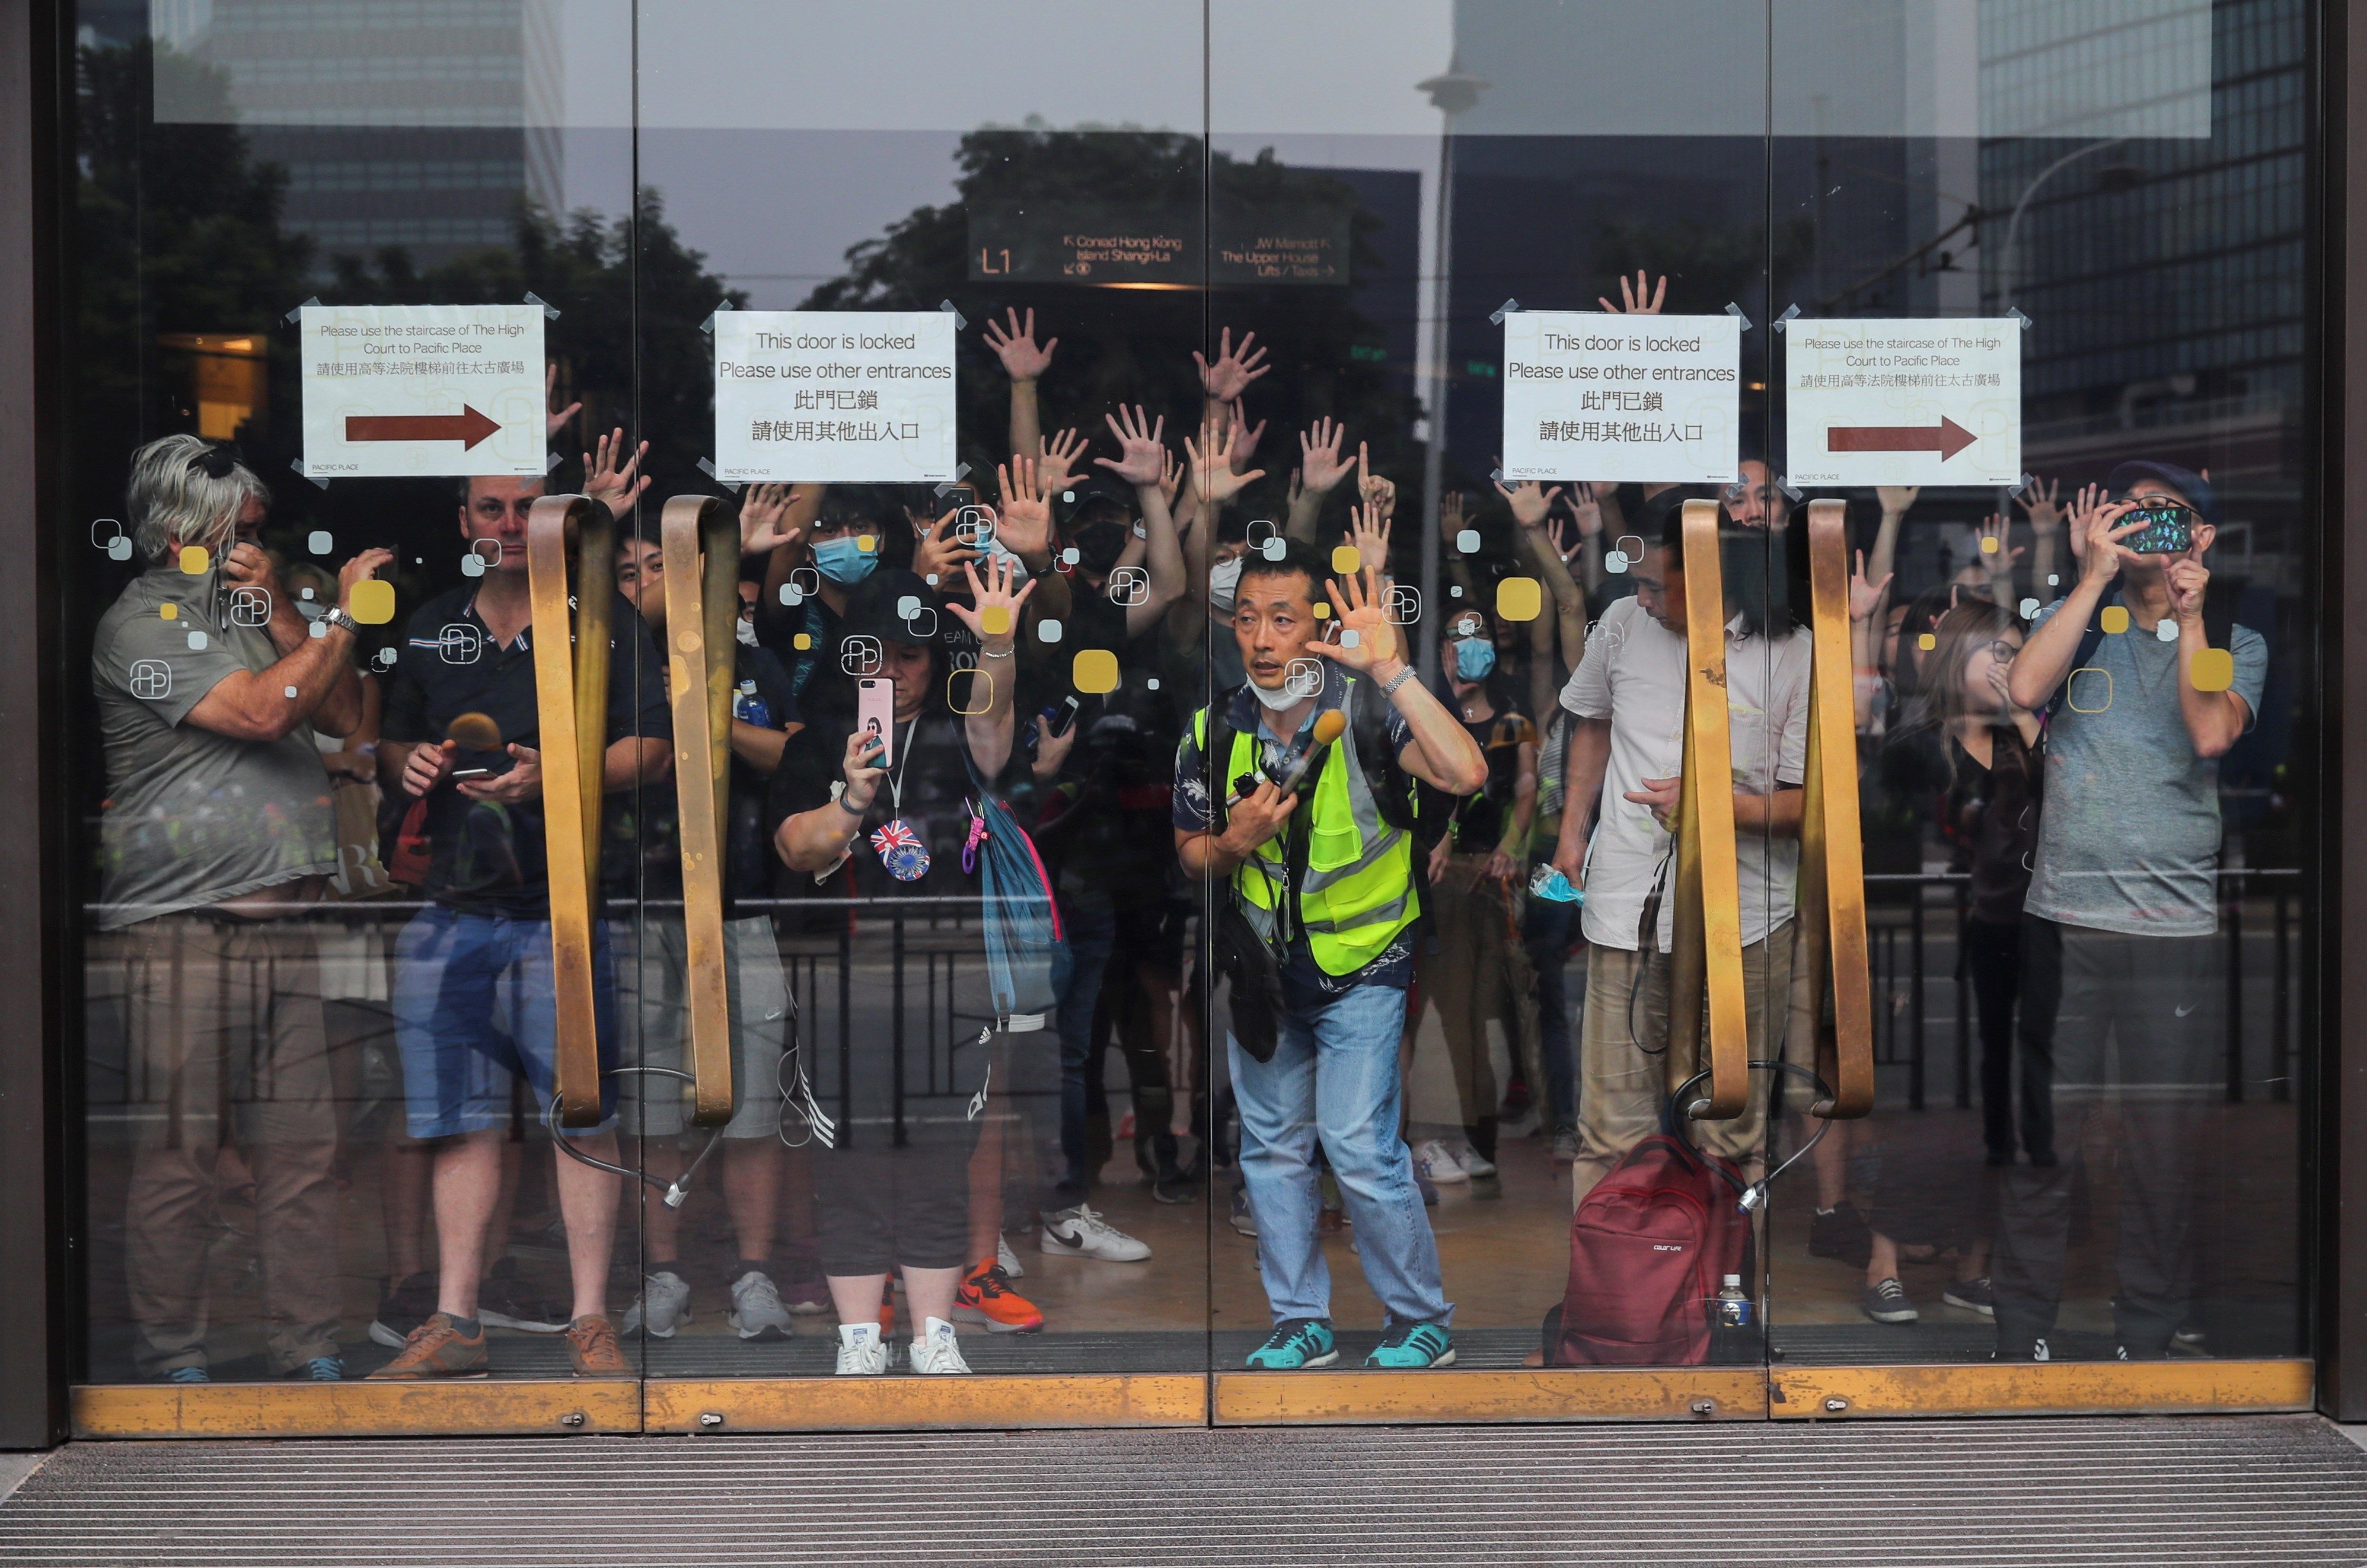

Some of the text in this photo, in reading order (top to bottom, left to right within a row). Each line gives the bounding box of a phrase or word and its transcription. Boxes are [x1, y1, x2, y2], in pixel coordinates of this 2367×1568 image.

[1077, 235, 1182, 252] Conrad Hong Kong
[982, 247, 1009, 274] L1
[1077, 250, 1171, 264] Island Shangri-La
[1221, 251, 1319, 265] The Upper House
[321, 324, 524, 337] Please use the staircase of The High
[364, 343, 482, 354] Court to Pacific Place
[755, 333, 914, 349] This door is locked
[1545, 334, 1699, 352] This door is locked
[1805, 337, 2001, 350] Please use the staircase of The High
[317, 360, 524, 376] 請使用高等法院樓梯前往太古廣場
[1846, 355, 1960, 366] Court to Pacific Place
[720, 362, 951, 378] Please use other entrances
[1510, 362, 1563, 379] Please
[1569, 367, 1599, 379] use
[1603, 364, 1648, 380] other
[1653, 366, 1735, 381] entrances
[1801, 373, 2000, 388] 請使用高等法院樓梯前往太古廣場
[794, 389, 878, 410] 此門已鎖
[1581, 391, 1663, 411] 此門已鎖
[752, 420, 918, 442] 請使用其他出入口
[1539, 421, 1702, 442] 請使用其他出入口
